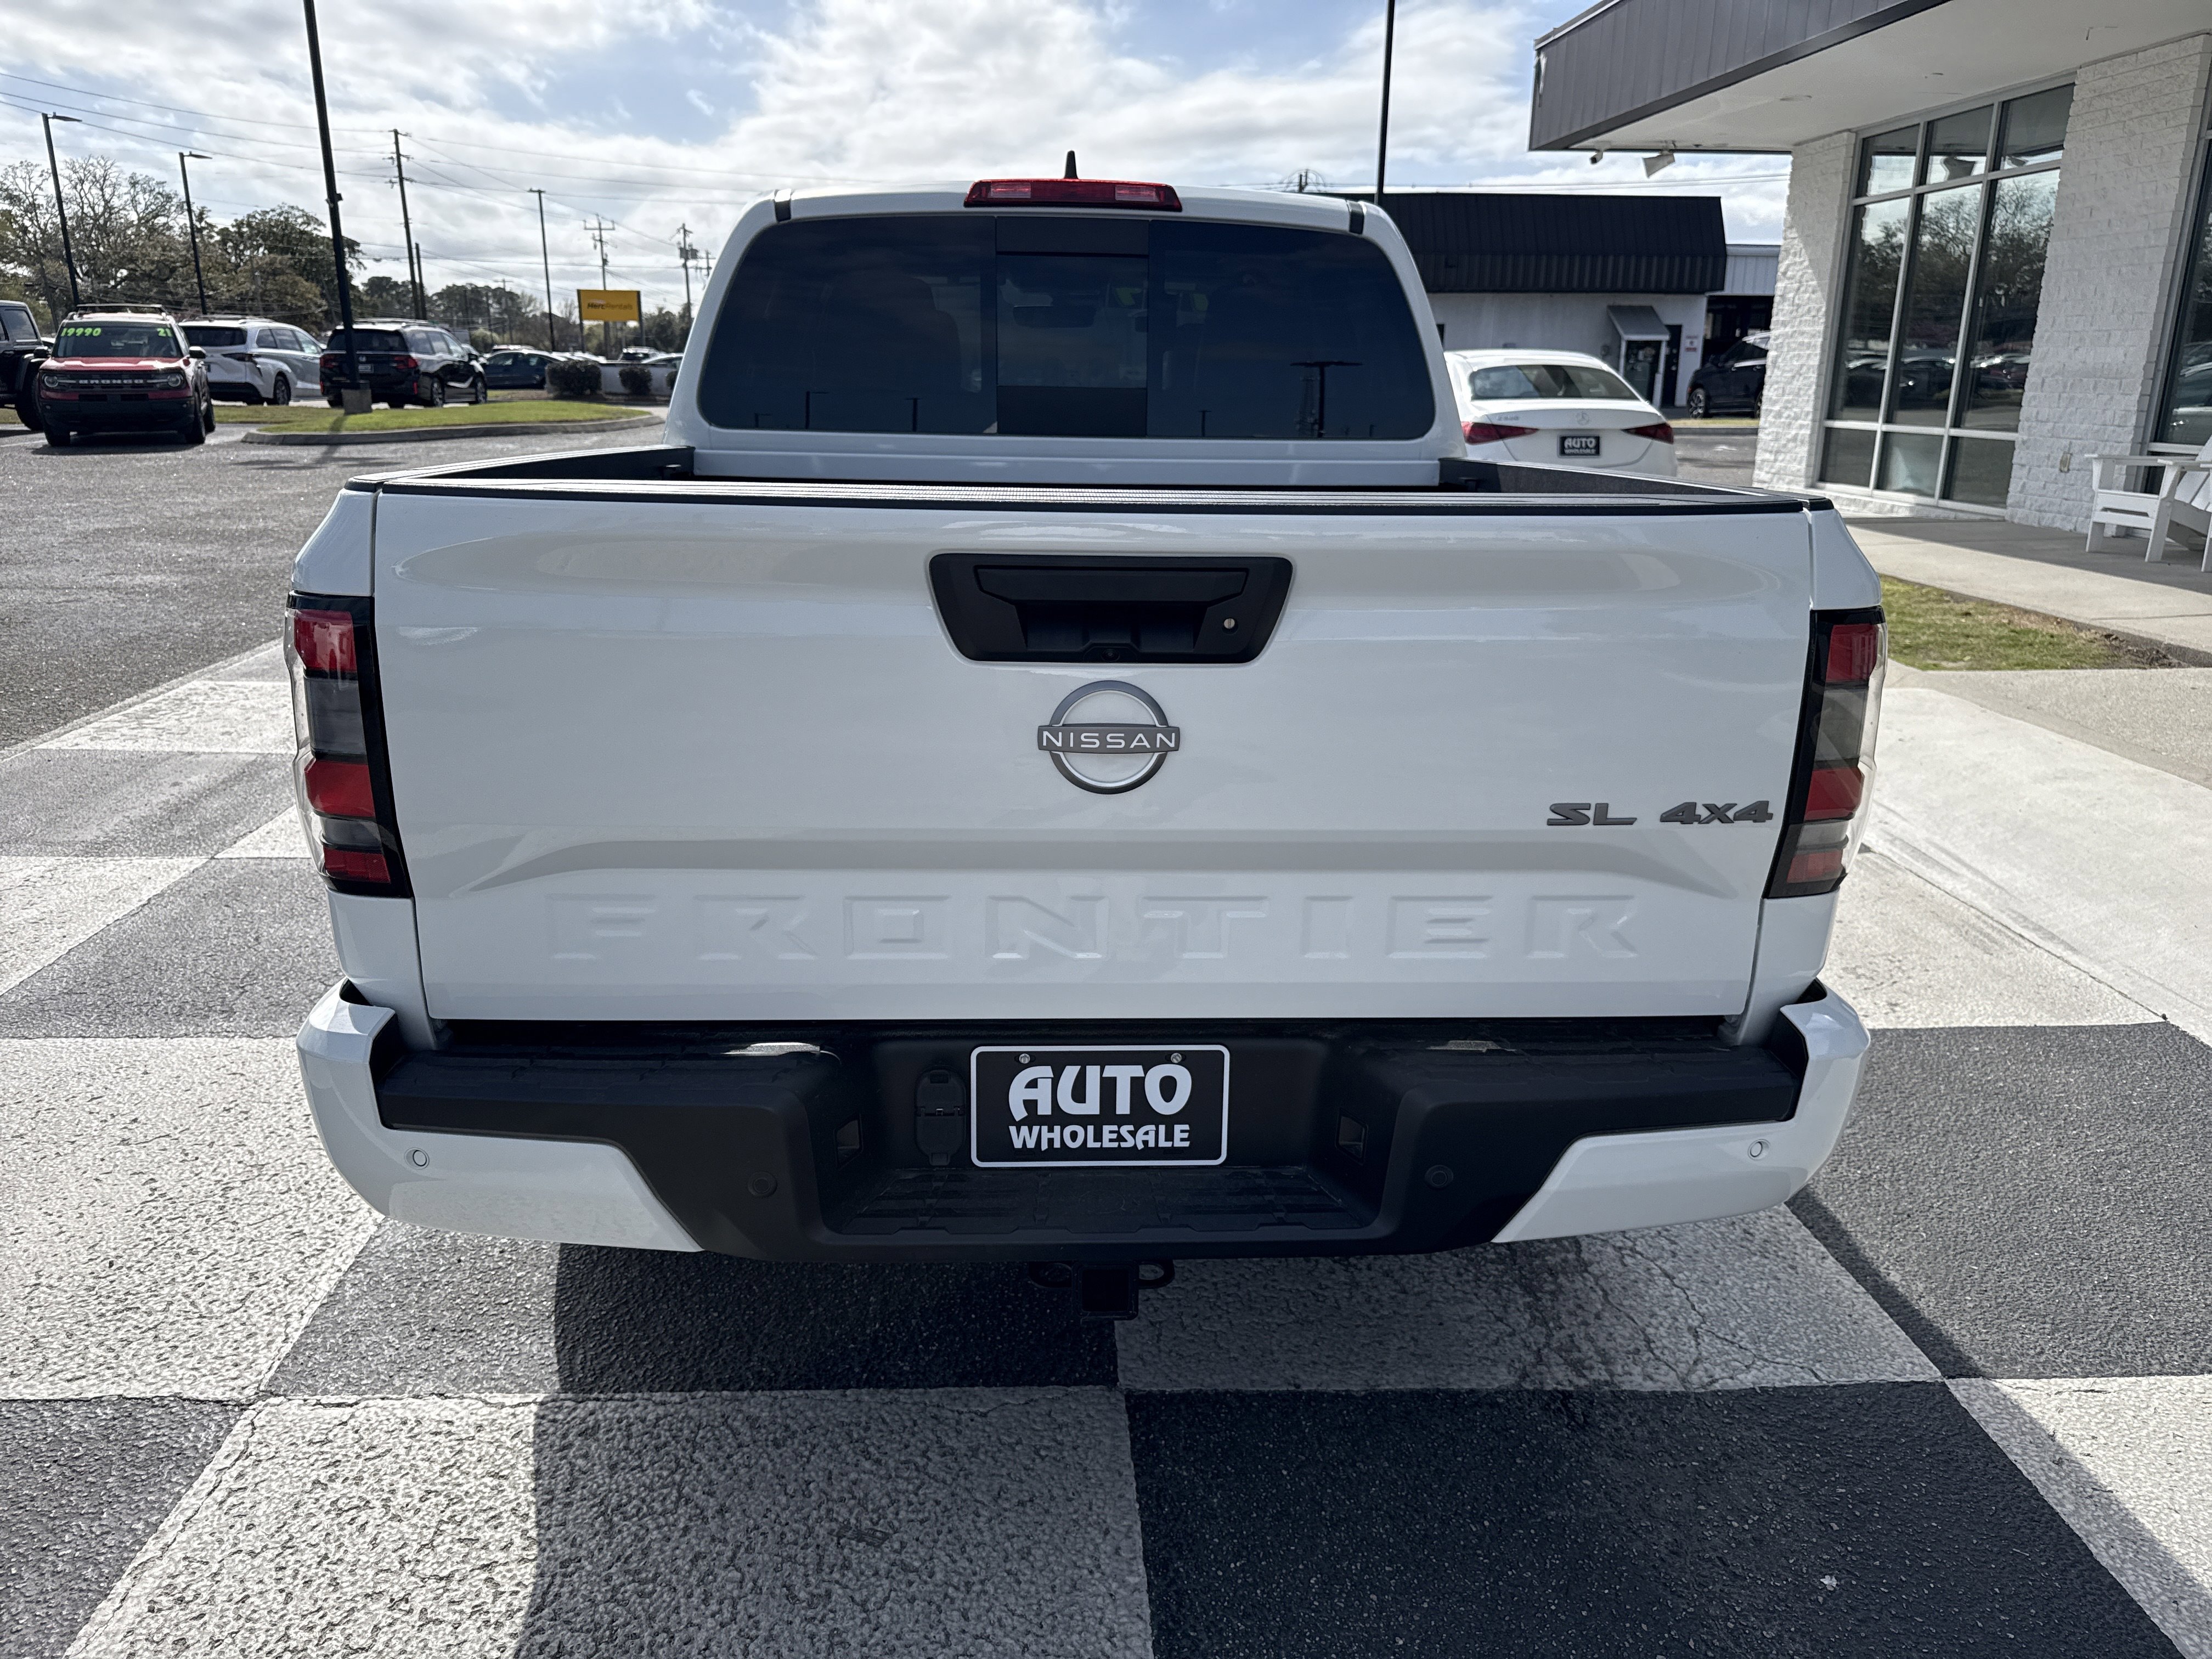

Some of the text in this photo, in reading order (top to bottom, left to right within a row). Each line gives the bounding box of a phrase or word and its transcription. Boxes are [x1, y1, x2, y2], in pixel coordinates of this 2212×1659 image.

[61, 328, 173, 337] 19990 21
[1564, 437, 1596, 448] AUTO
[1042, 731, 1175, 748] NISSAN
[1547, 803, 1637, 826] SL
[545, 894, 1639, 960] FRONTIER
[1008, 1063, 1192, 1121] AUTO
[1008, 1124, 1190, 1151] WHOLESALE
